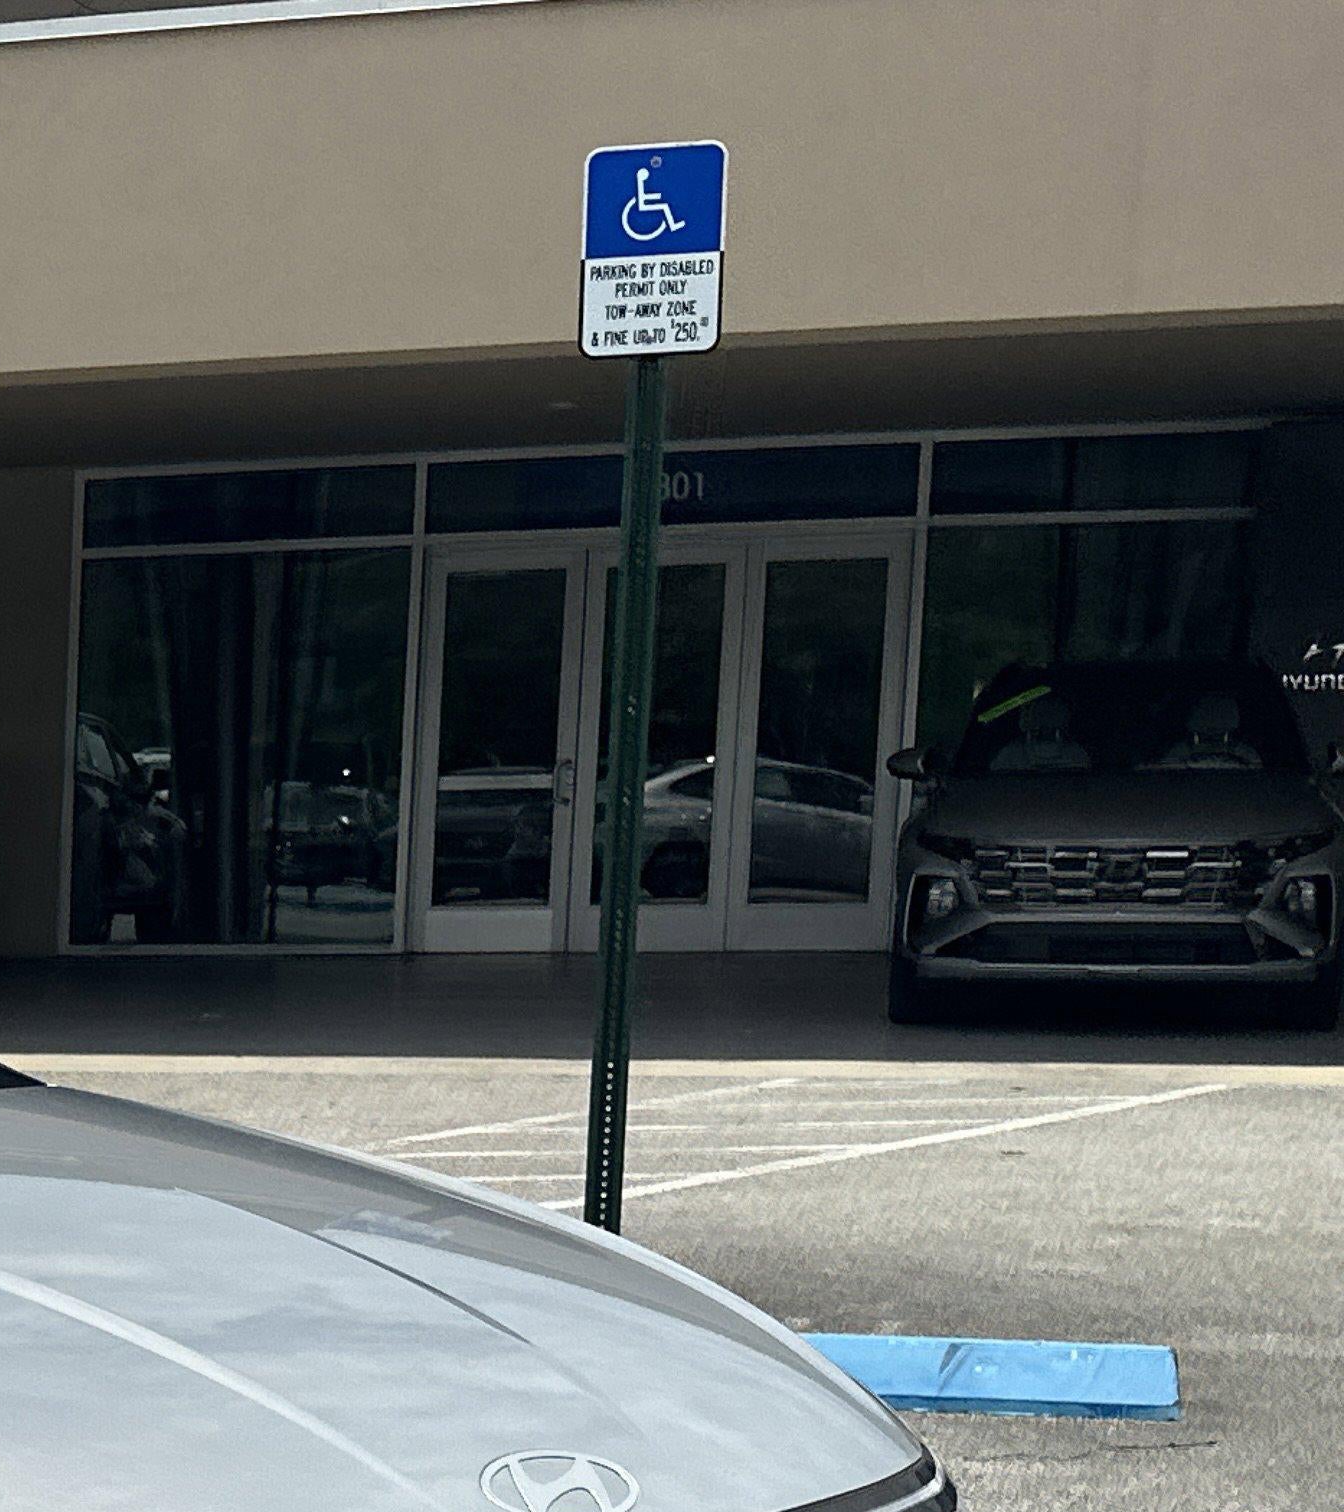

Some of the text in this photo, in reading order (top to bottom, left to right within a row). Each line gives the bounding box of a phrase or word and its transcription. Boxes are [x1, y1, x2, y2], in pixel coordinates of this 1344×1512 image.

[590, 259, 714, 281] PARKING BY DISABLED
[615, 280, 688, 298] PERMIT ONLY
[605, 299, 697, 320] TOW-AWAY ZONE
[591, 331, 599, 347] &
[604, 330, 628, 346] FINE
[652, 328, 666, 344] TO
